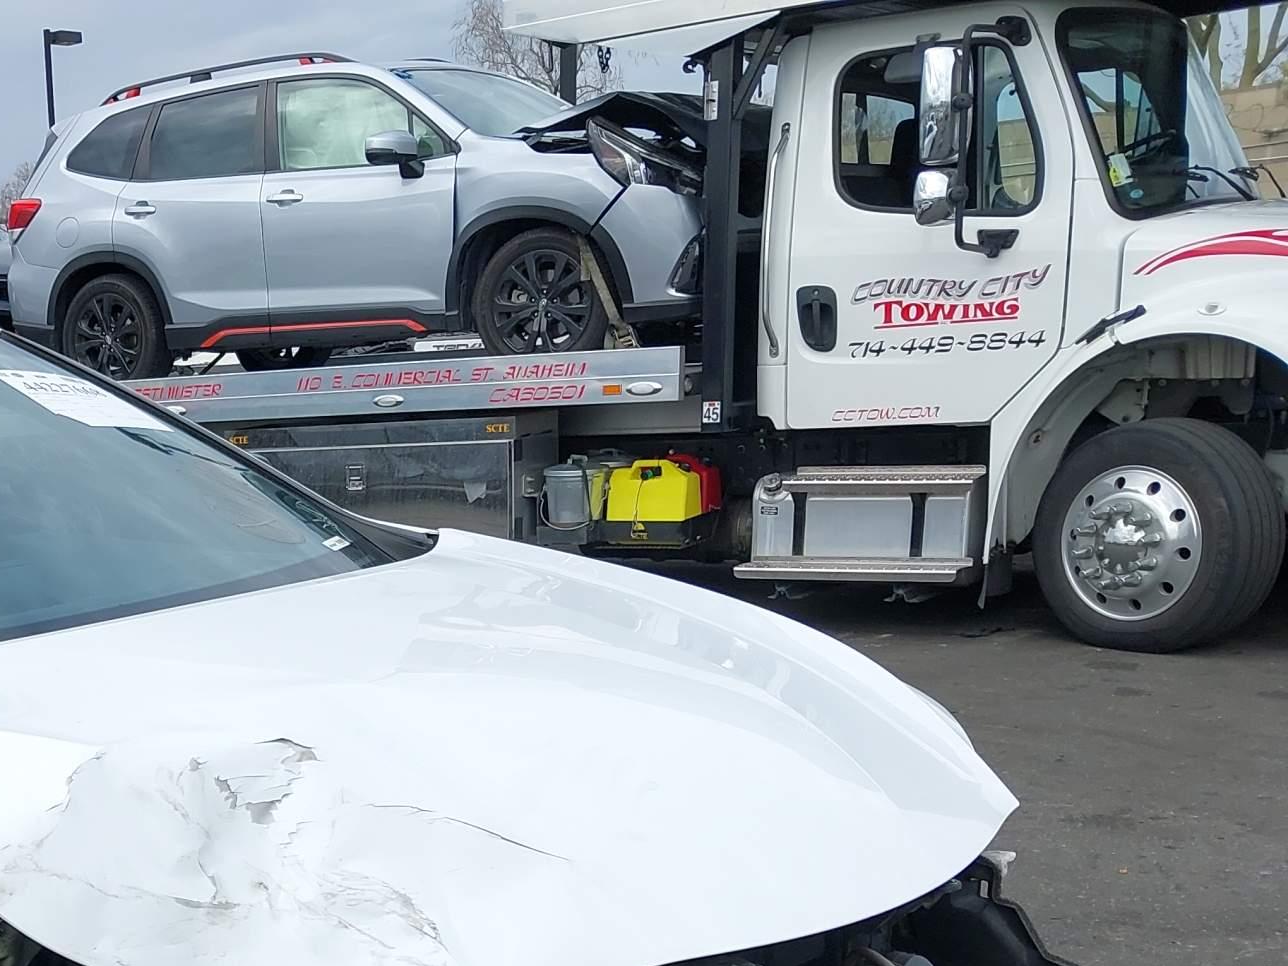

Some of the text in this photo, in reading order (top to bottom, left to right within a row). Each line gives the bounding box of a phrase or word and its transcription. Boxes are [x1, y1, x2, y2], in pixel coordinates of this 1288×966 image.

[852, 263, 1052, 303] COUNTRY CITY
[873, 298, 1020, 324] TOWING
[296, 376, 322, 393] 110
[351, 369, 463, 388] COMMERCIAL
[503, 362, 587, 380] ANAHEIM
[703, 407, 719, 422] 45
[832, 406, 941, 422] CCTOW.COM
[486, 424, 511, 433] SCTE
